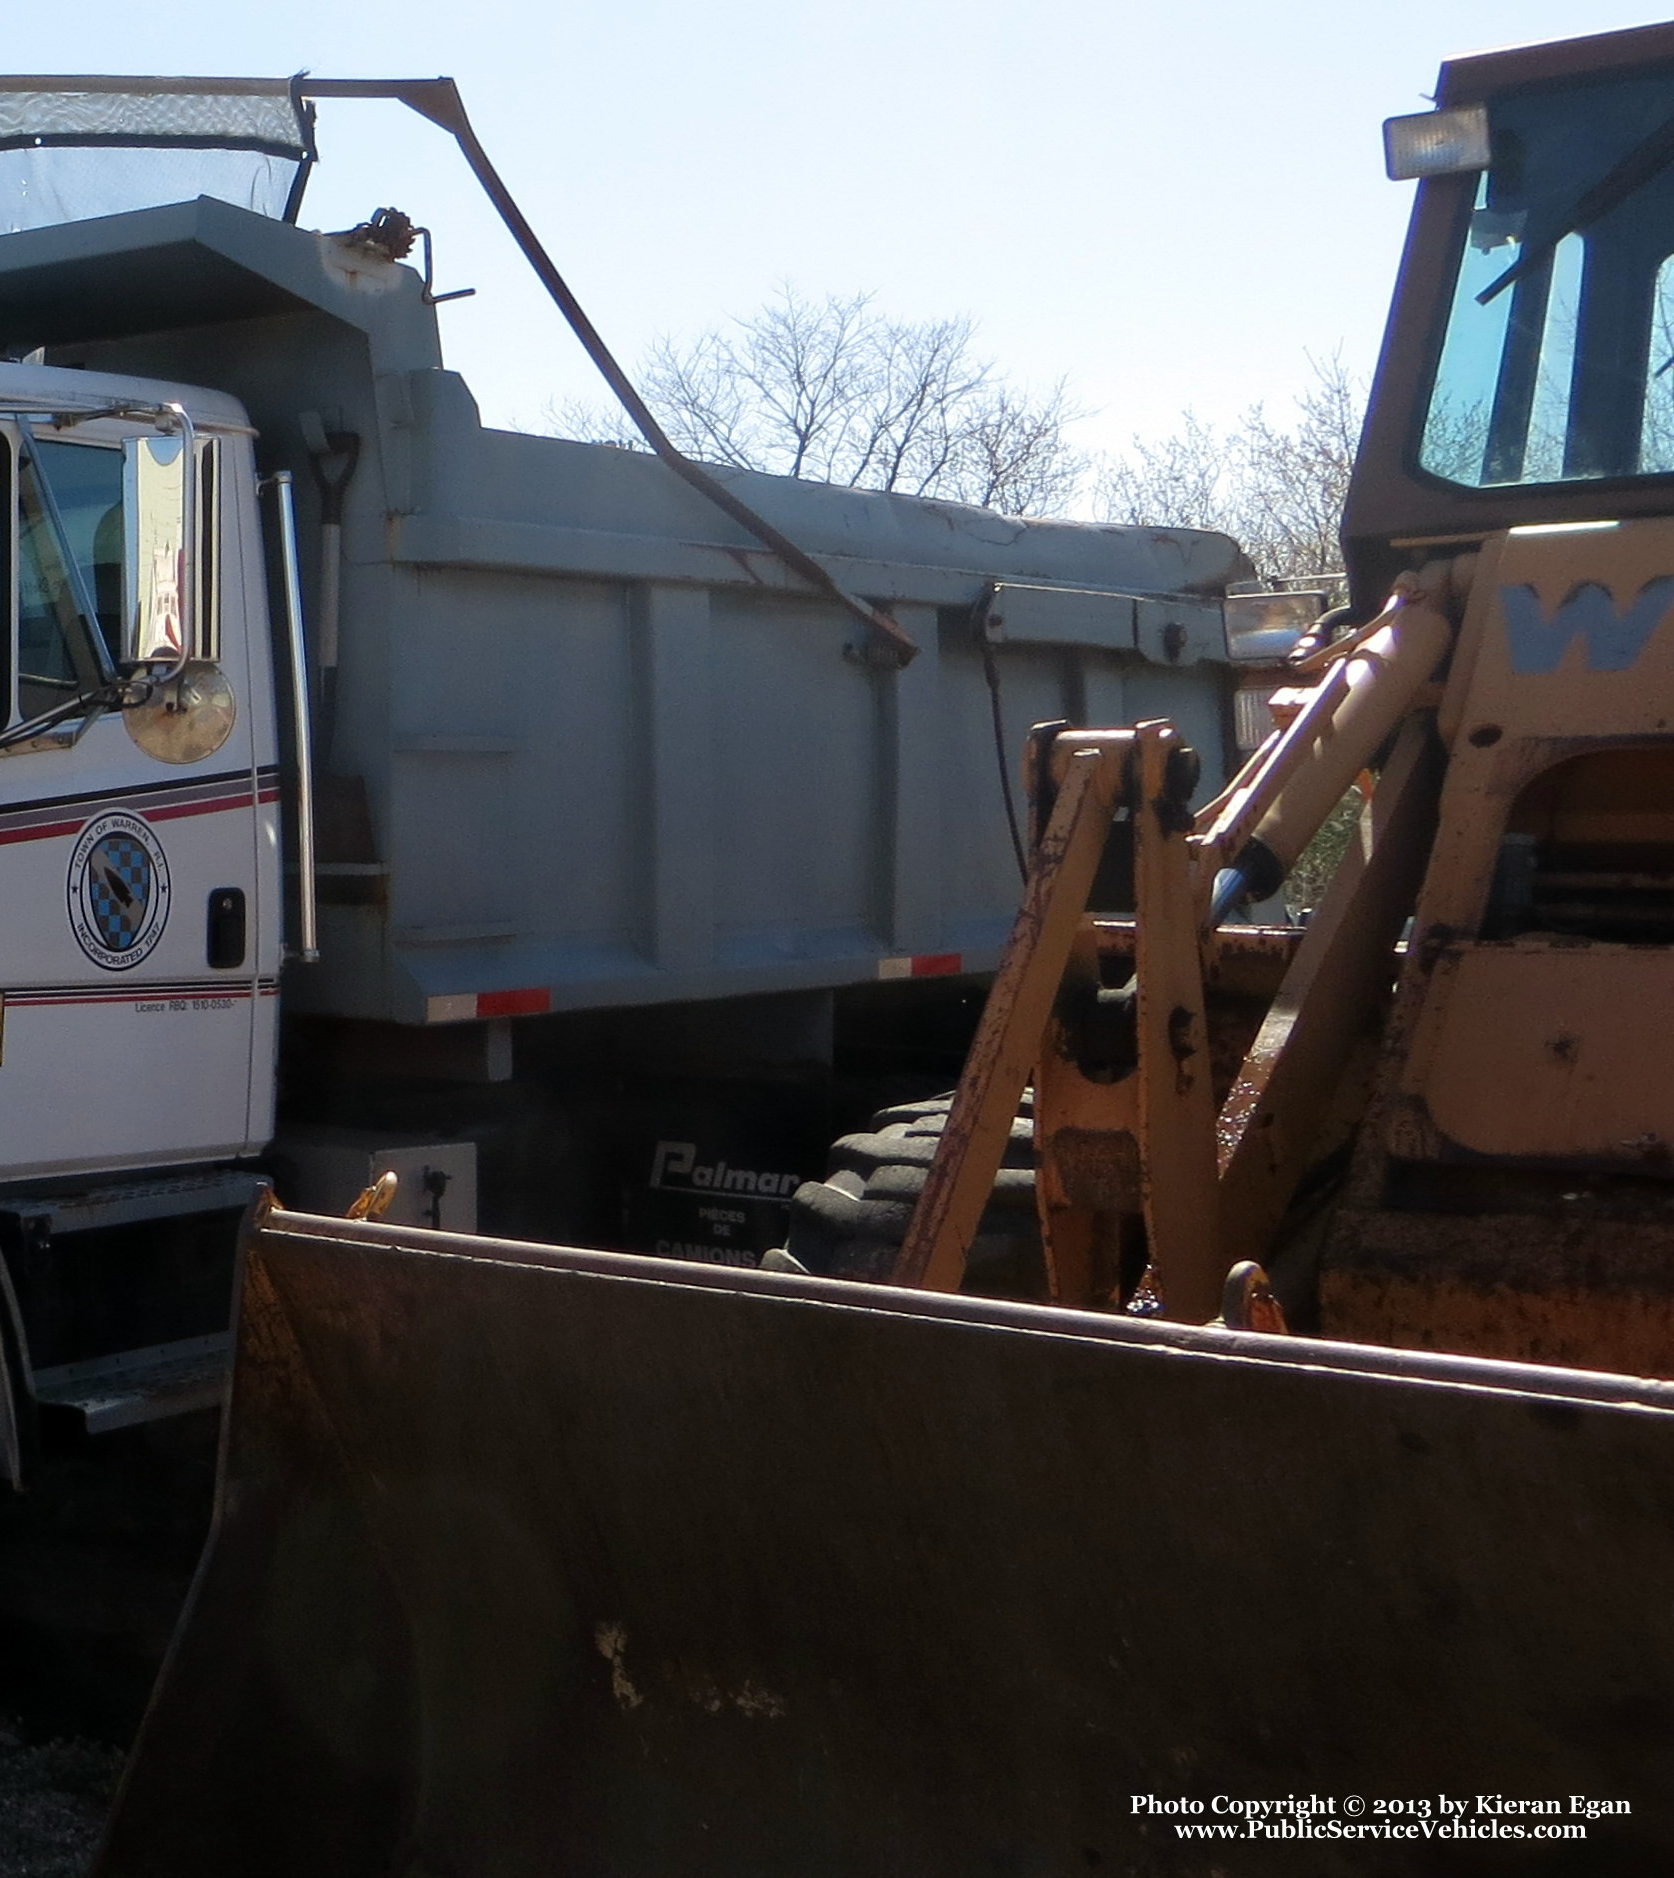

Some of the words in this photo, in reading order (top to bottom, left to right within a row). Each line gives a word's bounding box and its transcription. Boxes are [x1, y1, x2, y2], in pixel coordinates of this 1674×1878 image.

[75, 834, 95, 870] TOWN
[95, 821, 108, 836] OF
[77, 922, 142, 966] INCORPORATED
[145, 921, 161, 948] 1747
[649, 1140, 801, 1195] Palmar
[713, 1223, 731, 1236] DE
[655, 1239, 756, 1267] CAMIONS
